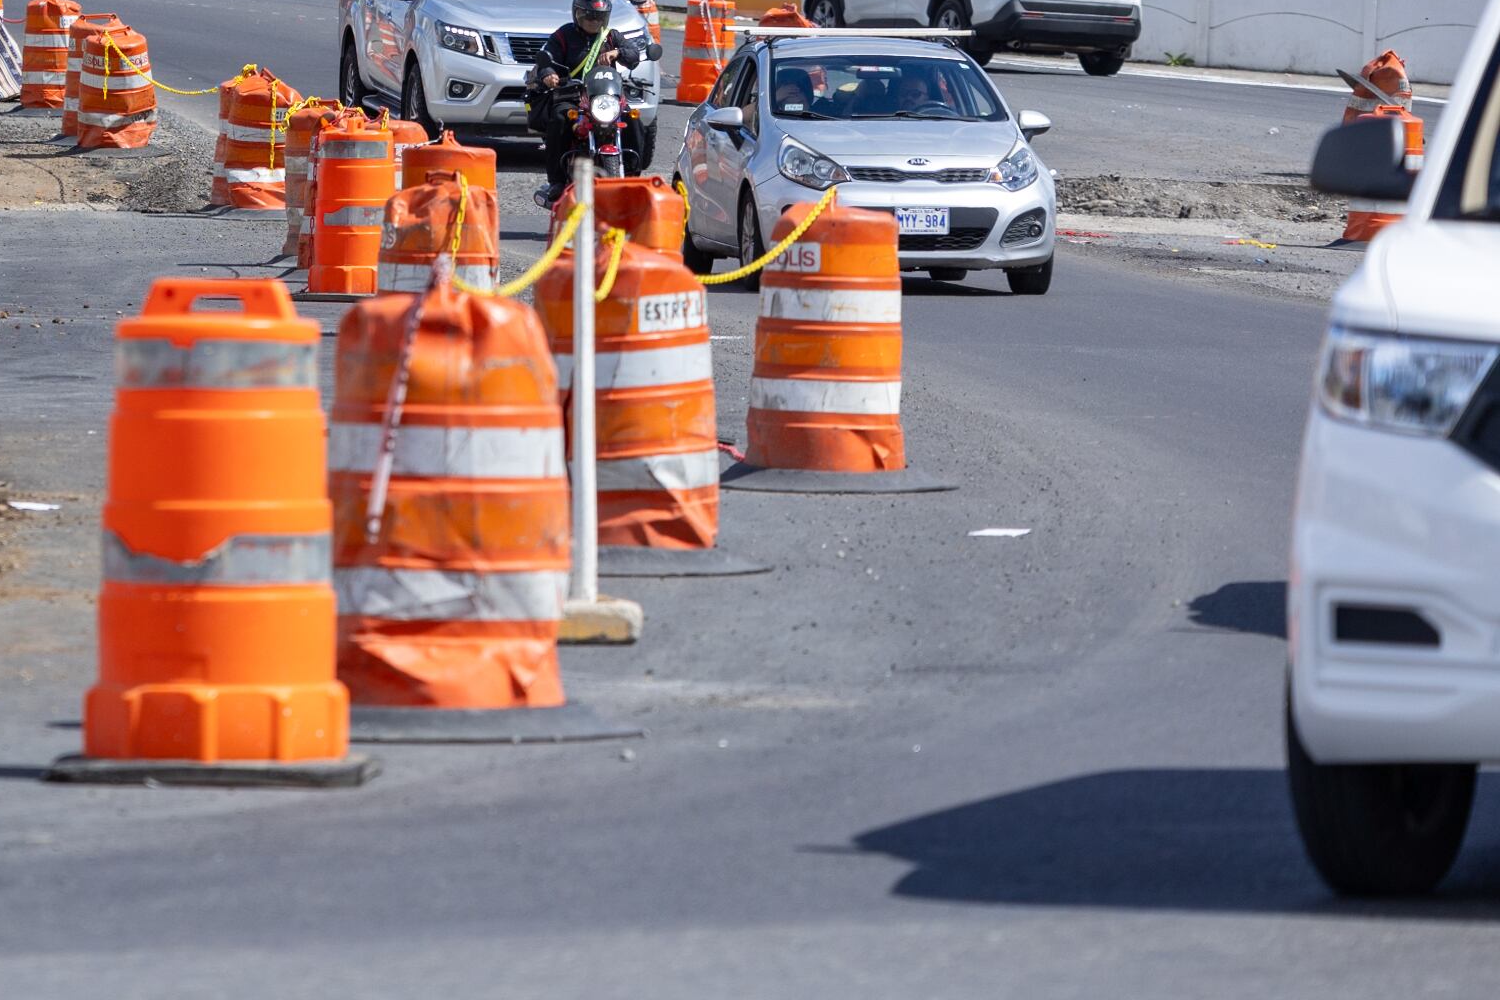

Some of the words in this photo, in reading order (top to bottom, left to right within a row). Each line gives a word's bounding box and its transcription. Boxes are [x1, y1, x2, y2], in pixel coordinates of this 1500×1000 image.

[594, 71, 614, 81] 44
[910, 158, 929, 166] KIA
[896, 214, 946, 228] MYY-984
